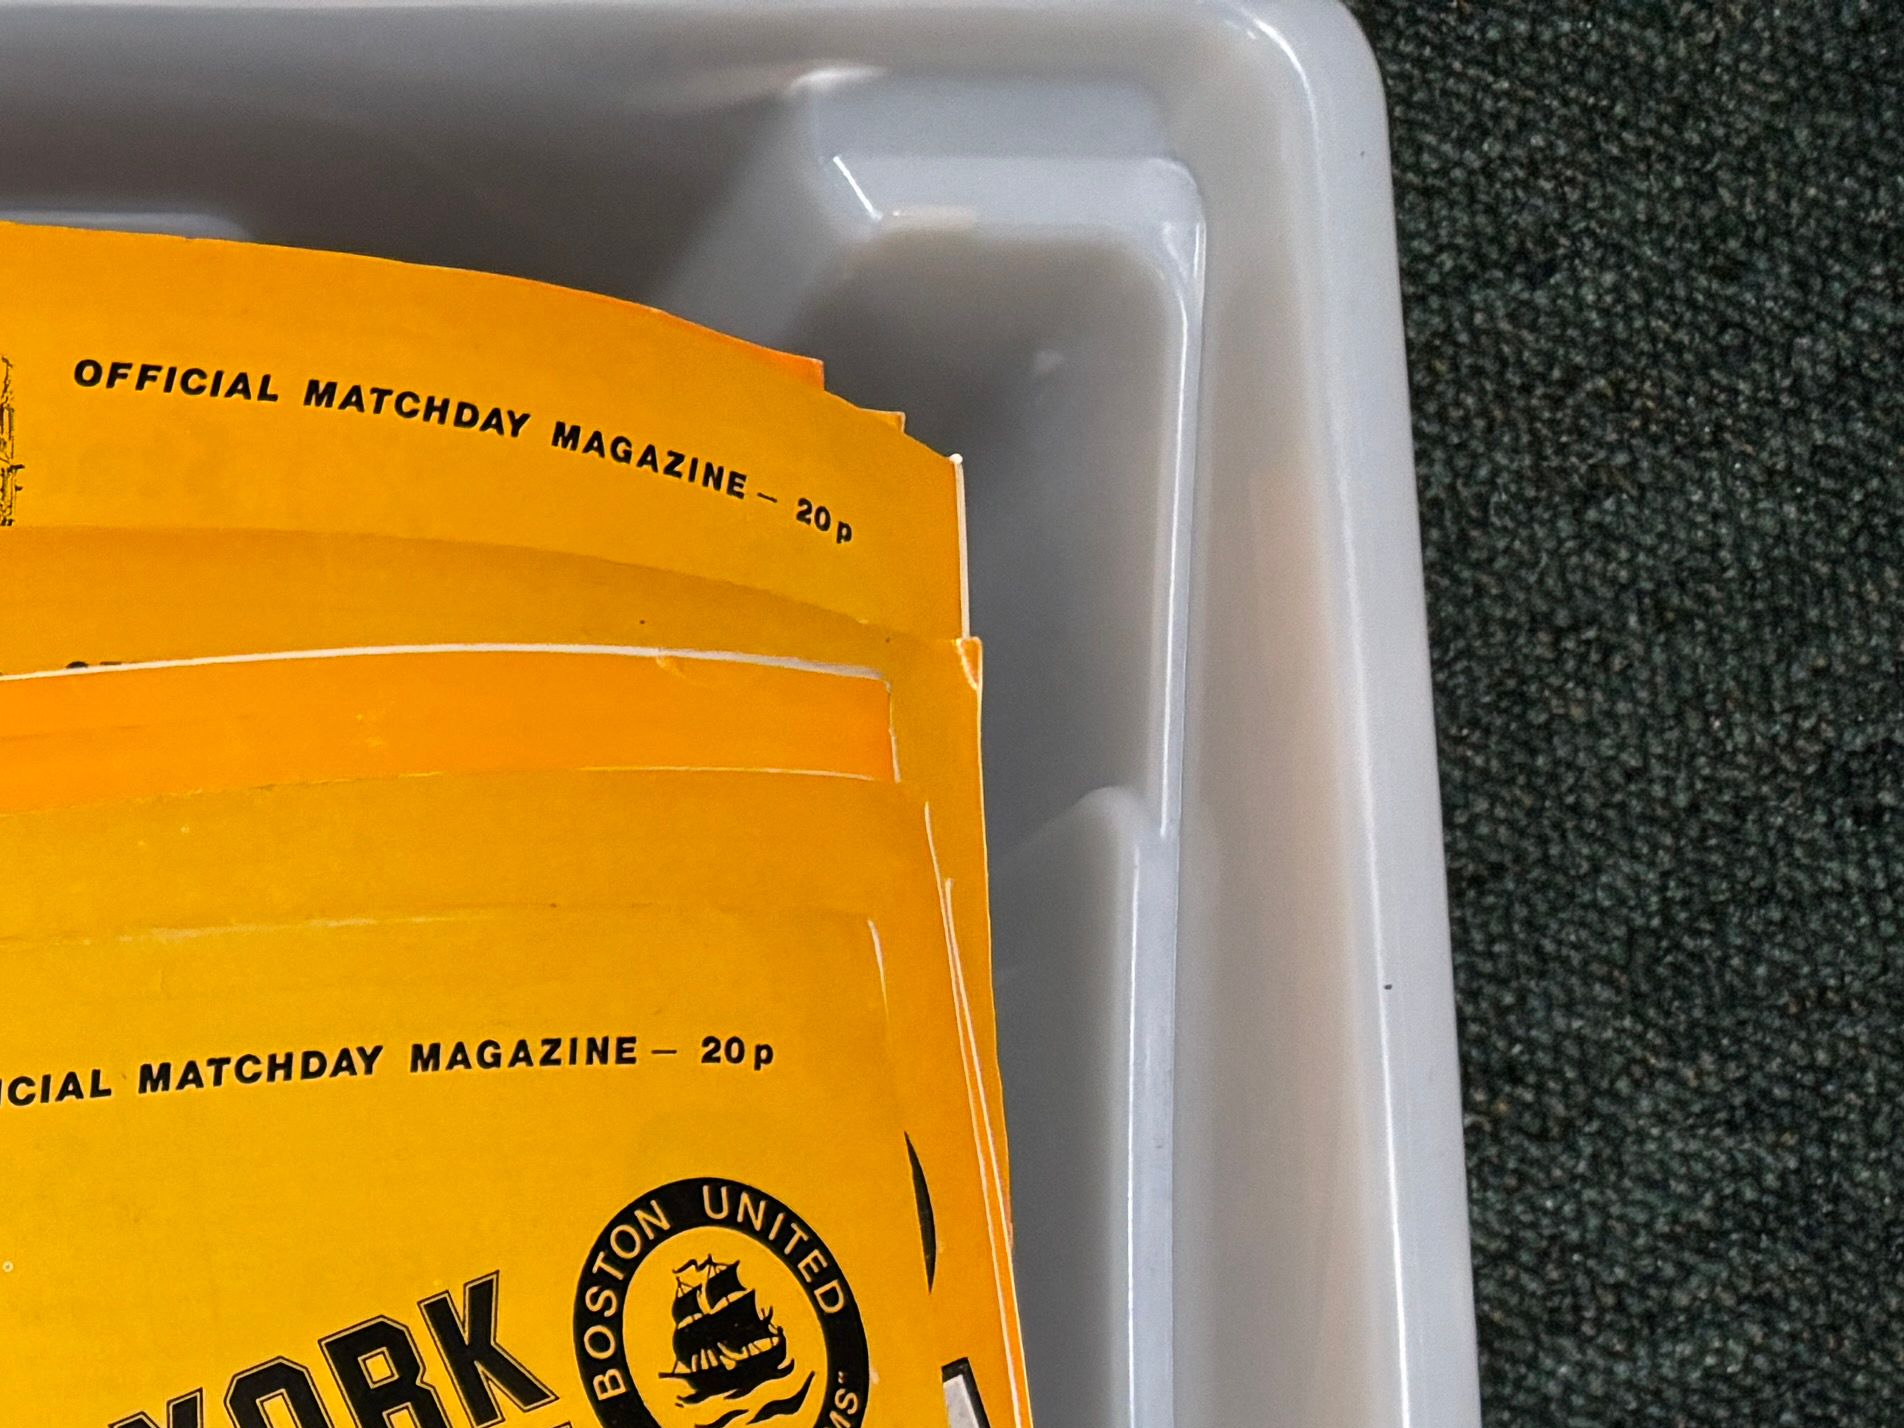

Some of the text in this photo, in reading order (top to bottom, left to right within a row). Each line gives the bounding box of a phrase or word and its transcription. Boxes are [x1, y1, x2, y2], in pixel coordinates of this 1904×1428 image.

[75, 360, 278, 401] OFFICIAL
[304, 380, 530, 437] MATCHDAY
[552, 421, 746, 499] MAGAZINE
[797, 498, 852, 543] 20p
[139, 1046, 383, 1093] MATCHDAY
[411, 1036, 636, 1072] MAGAZINE
[702, 1036, 773, 1070] 20p
[584, 1185, 846, 1400] BOSTON UNITED
